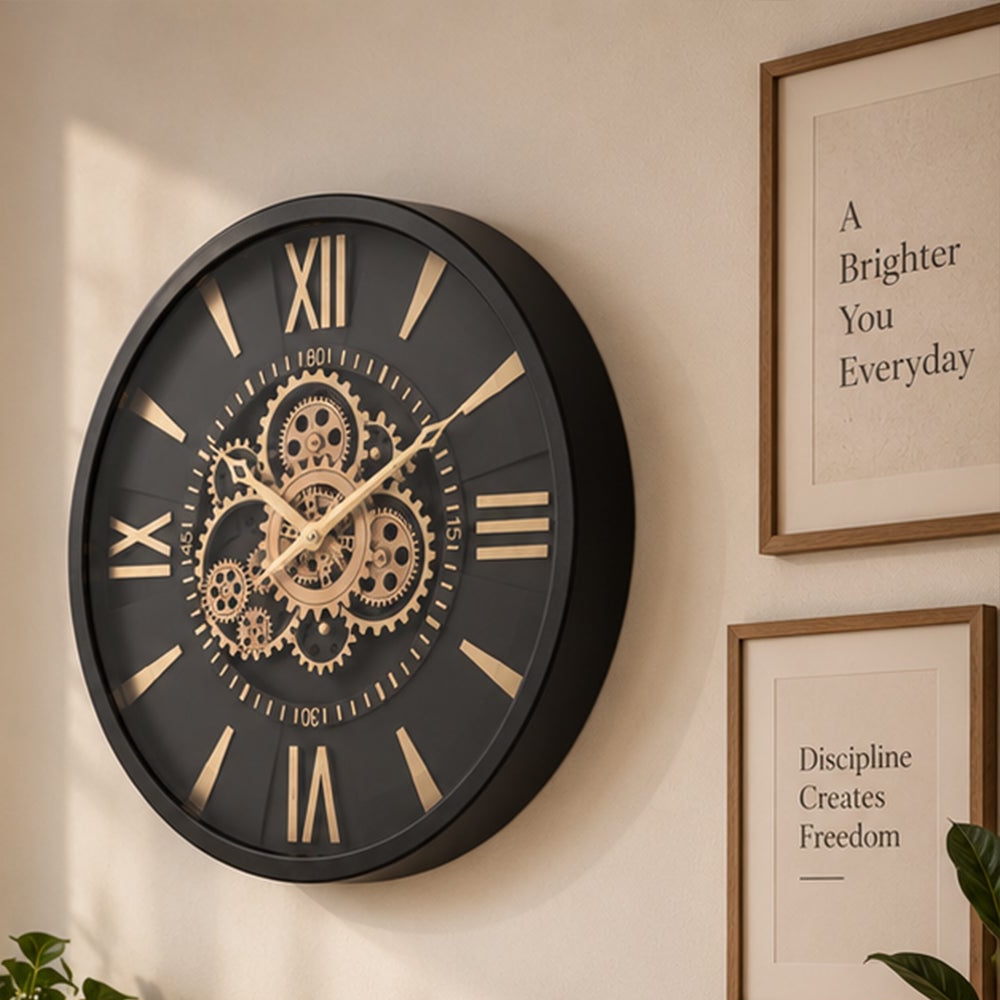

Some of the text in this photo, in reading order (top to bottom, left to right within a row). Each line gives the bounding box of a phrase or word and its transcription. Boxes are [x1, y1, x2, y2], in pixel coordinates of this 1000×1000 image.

[839, 200, 862, 233] A
[839, 241, 961, 287] Brighter
[284, 234, 346, 333] XII
[839, 303, 894, 335] You
[839, 342, 975, 388] Everyday
[799, 743, 912, 776] Discipline
[799, 785, 886, 810] Creates
[799, 822, 900, 849] Freedom
